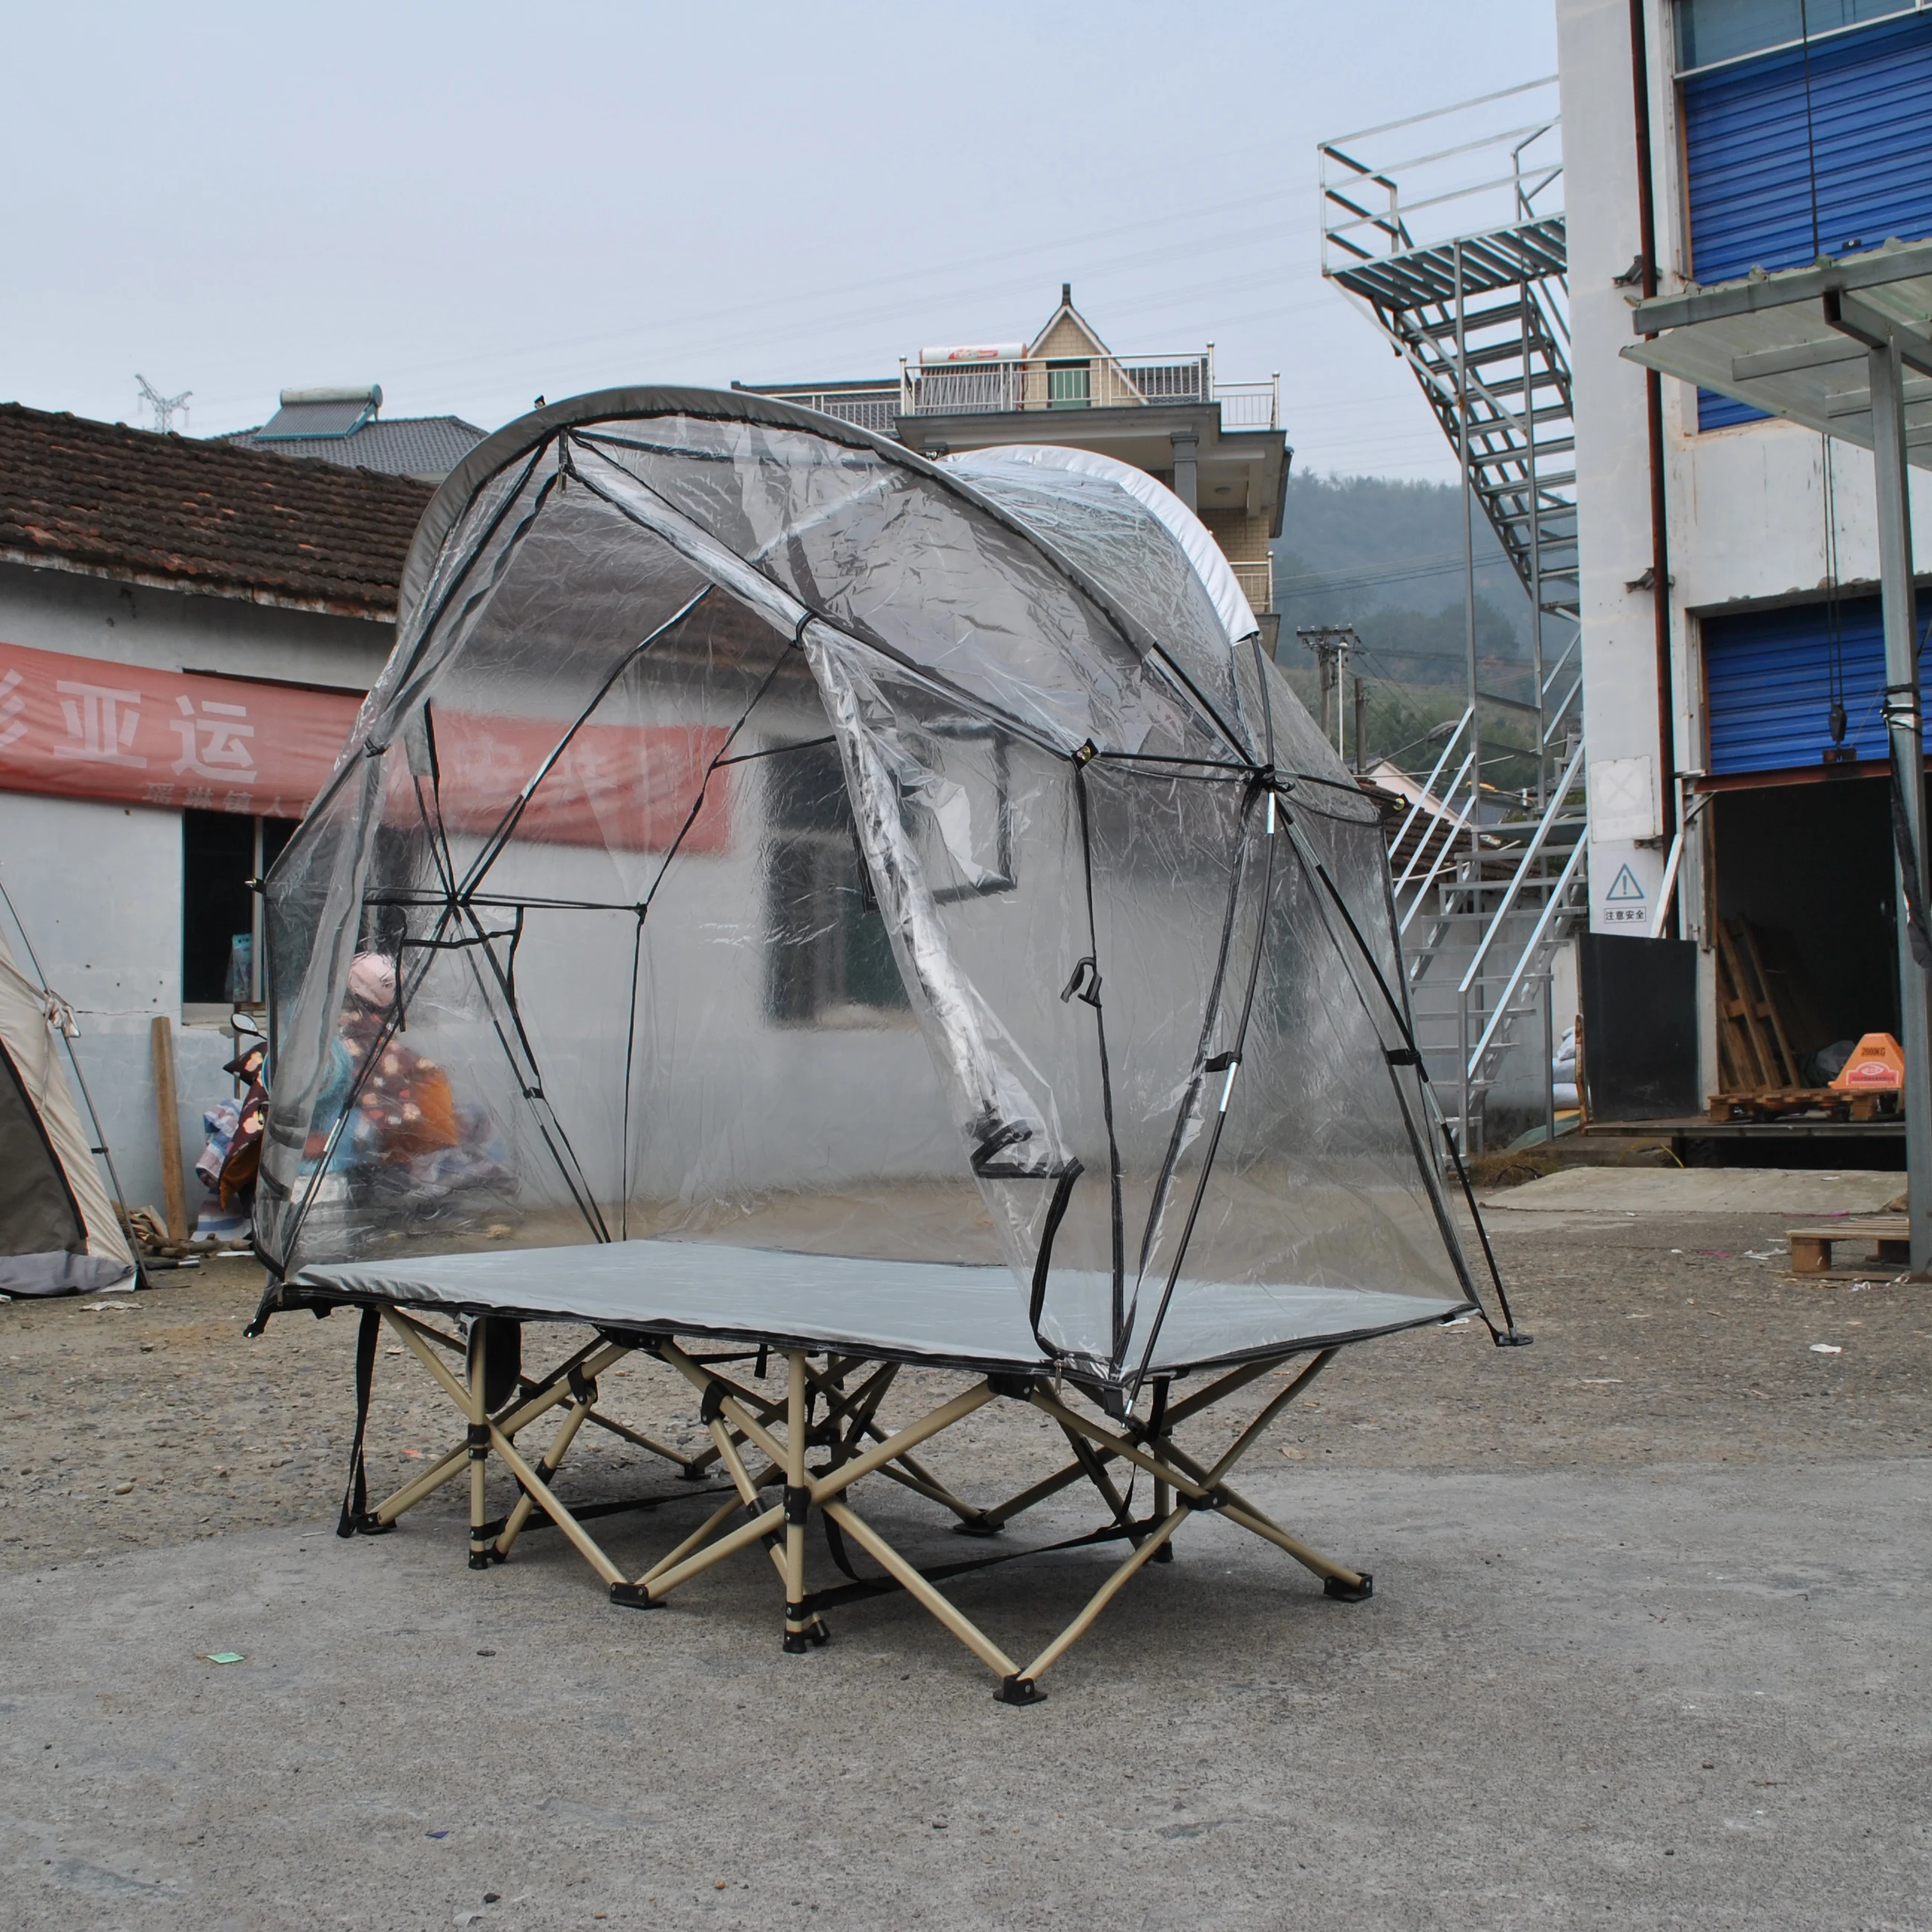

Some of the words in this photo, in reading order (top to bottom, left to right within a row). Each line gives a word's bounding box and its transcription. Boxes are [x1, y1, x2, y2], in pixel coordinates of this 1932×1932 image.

[1605, 909, 1645, 921] 注意安全
[1861, 1046, 1886, 1056] 2000KG
